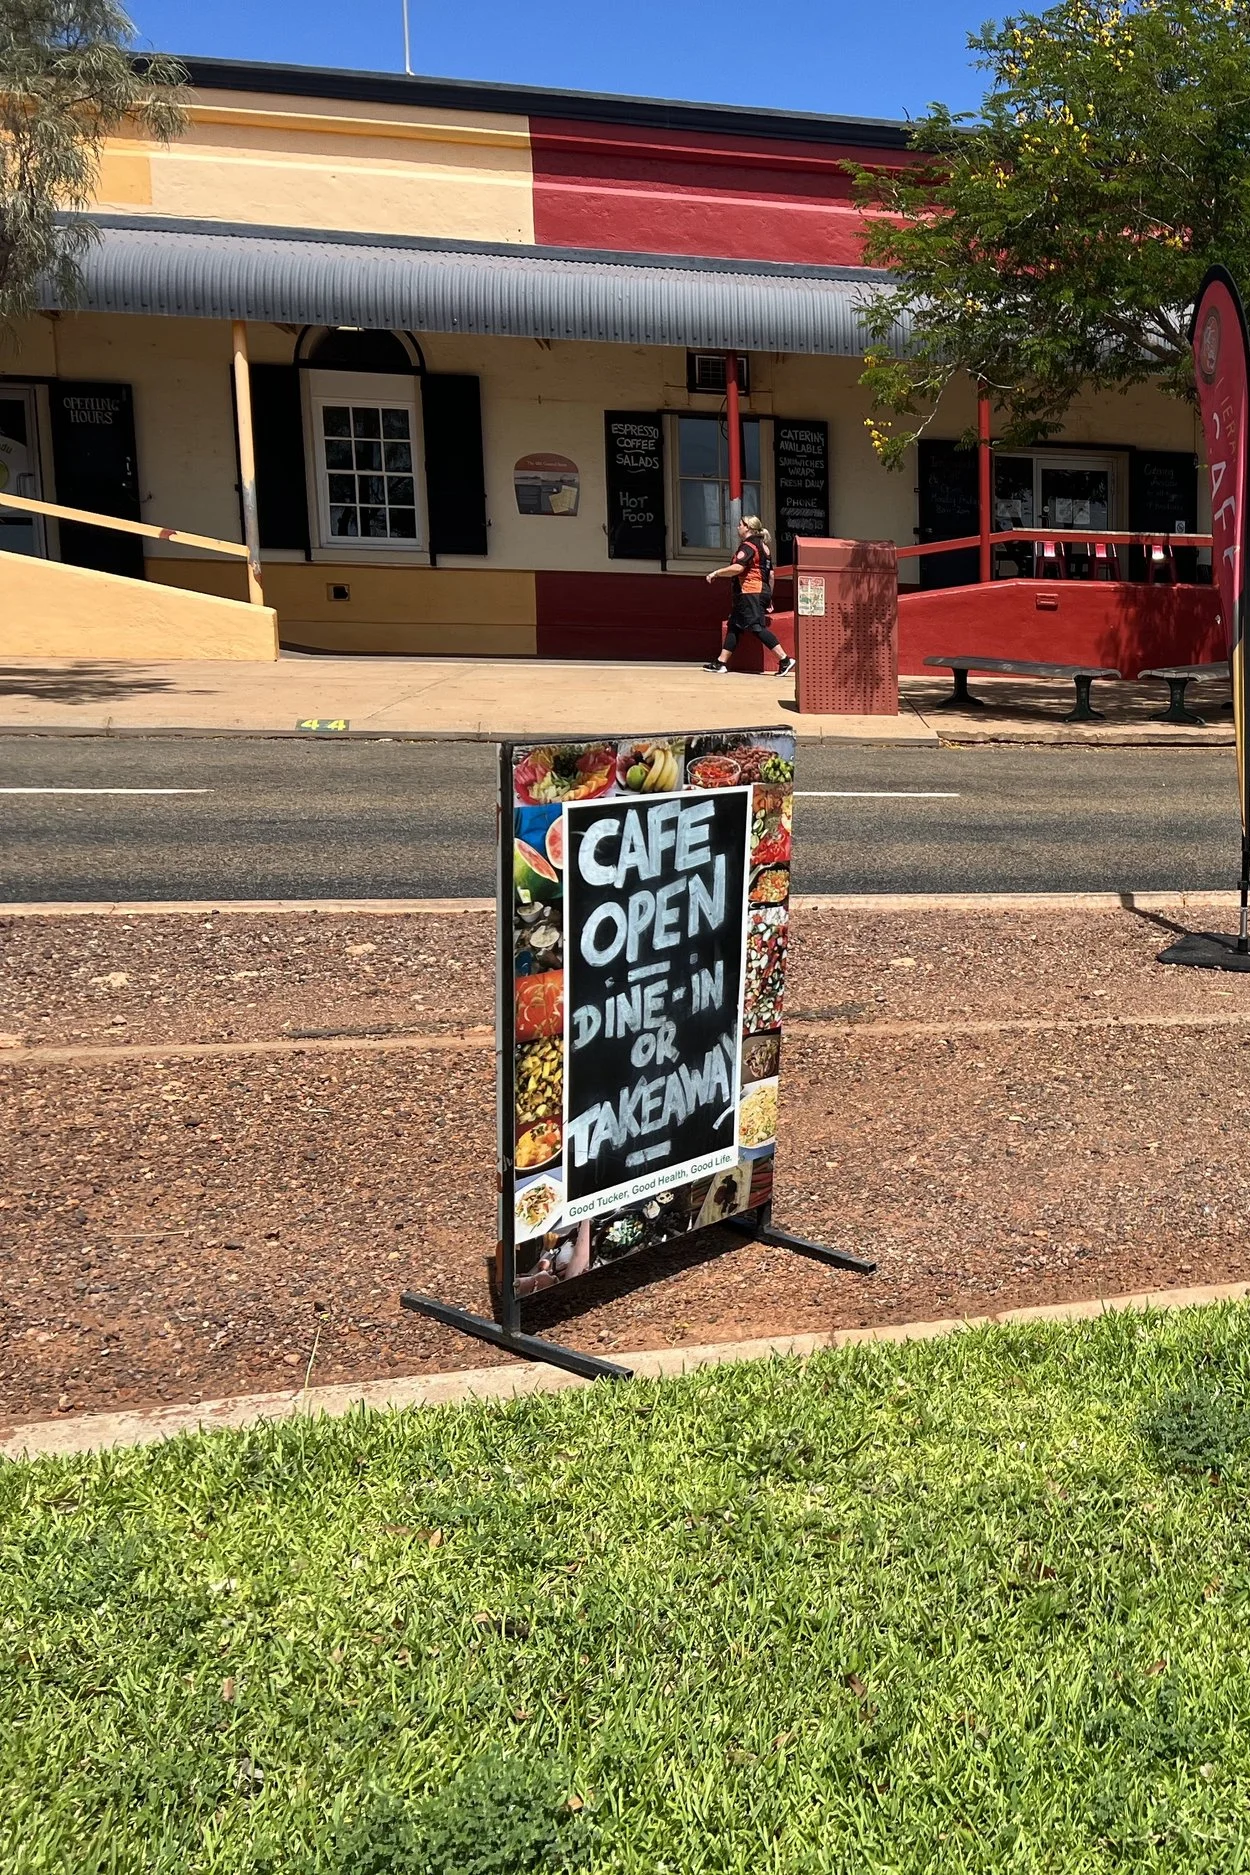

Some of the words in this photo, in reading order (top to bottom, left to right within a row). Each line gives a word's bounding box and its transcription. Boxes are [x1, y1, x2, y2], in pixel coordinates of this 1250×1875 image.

[63, 397, 120, 411] OPENING
[70, 410, 113, 424] HOURS
[611, 423, 660, 439] ESPRESSO
[780, 429, 825, 447] CATERING
[616, 437, 656, 450] COFFEE
[779, 441, 823, 455] AVAILABLE
[616, 454, 660, 469] SALADS
[779, 456, 825, 469] SANDWICHES
[788, 467, 815, 477] WRAPS
[780, 477, 803, 488] FRESH
[805, 479, 824, 491] DAILY
[619, 491, 648, 508] HOT
[786, 497, 817, 508] PHONE
[622, 509, 654, 522] FOOD
[578, 799, 716, 889] CAFE
[580, 853, 726, 967] OPEN
[631, 1020, 680, 1068] OR
[566, 1019, 738, 1168] TAKEAWAY
[569, 1201, 595, 1217] Good
[597, 1190, 630, 1207] Tucker,
[631, 1178, 656, 1194] Good
[658, 1168, 689, 1185] Health,
[690, 1160, 714, 1174] Good
[715, 1154, 733, 1167] Life.
